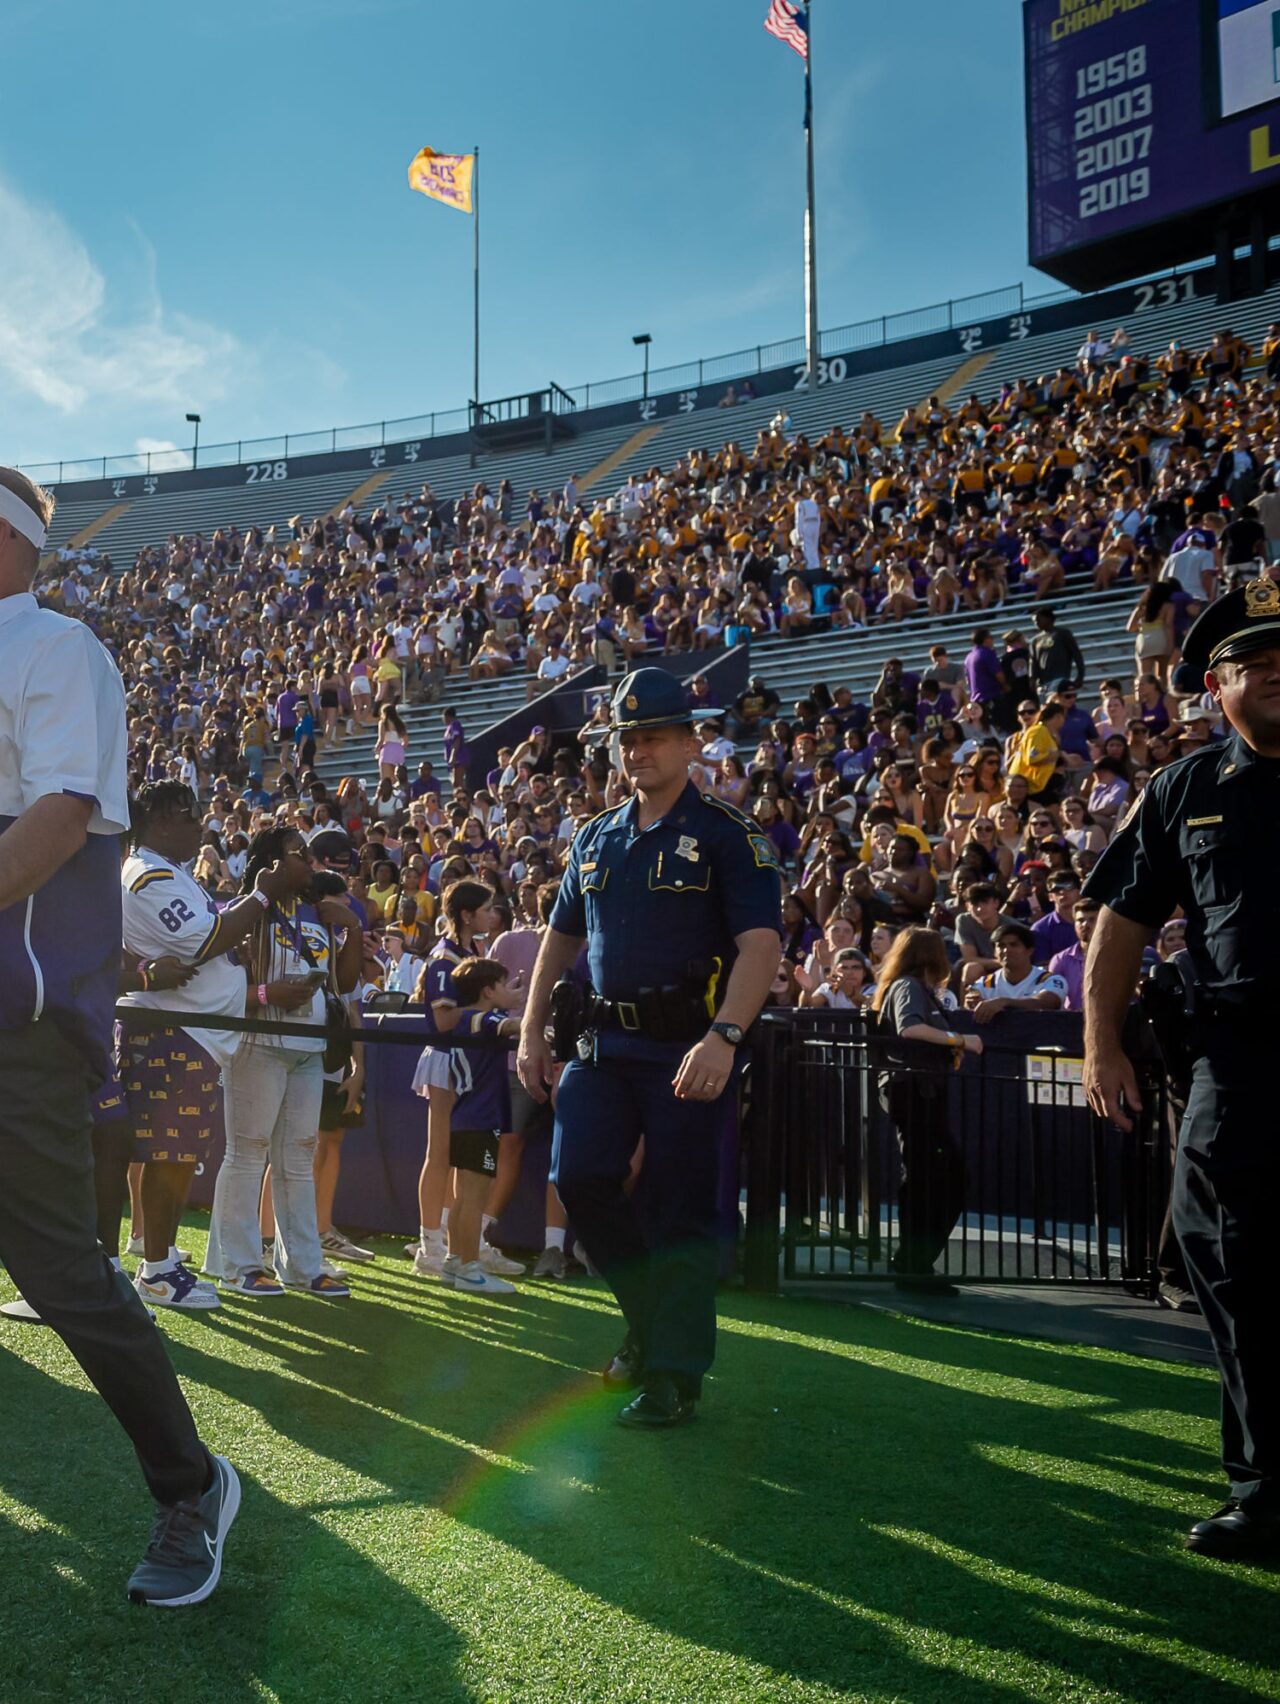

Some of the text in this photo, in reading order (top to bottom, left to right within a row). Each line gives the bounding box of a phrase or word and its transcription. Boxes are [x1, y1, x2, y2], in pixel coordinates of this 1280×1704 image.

[1076, 45, 1146, 99] 1958
[1075, 83, 1152, 141] 2003
[1076, 125, 1153, 180] 2007
[1080, 166, 1150, 219] 2019
[1133, 274, 1197, 313] 231
[246, 461, 288, 484] 228
[158, 898, 196, 933] 82
[436, 970, 446, 992] 7
[99, 1096, 121, 1109] LSU
[179, 1106, 200, 1115] LSU
[177, 1152, 196, 1162] LSU
